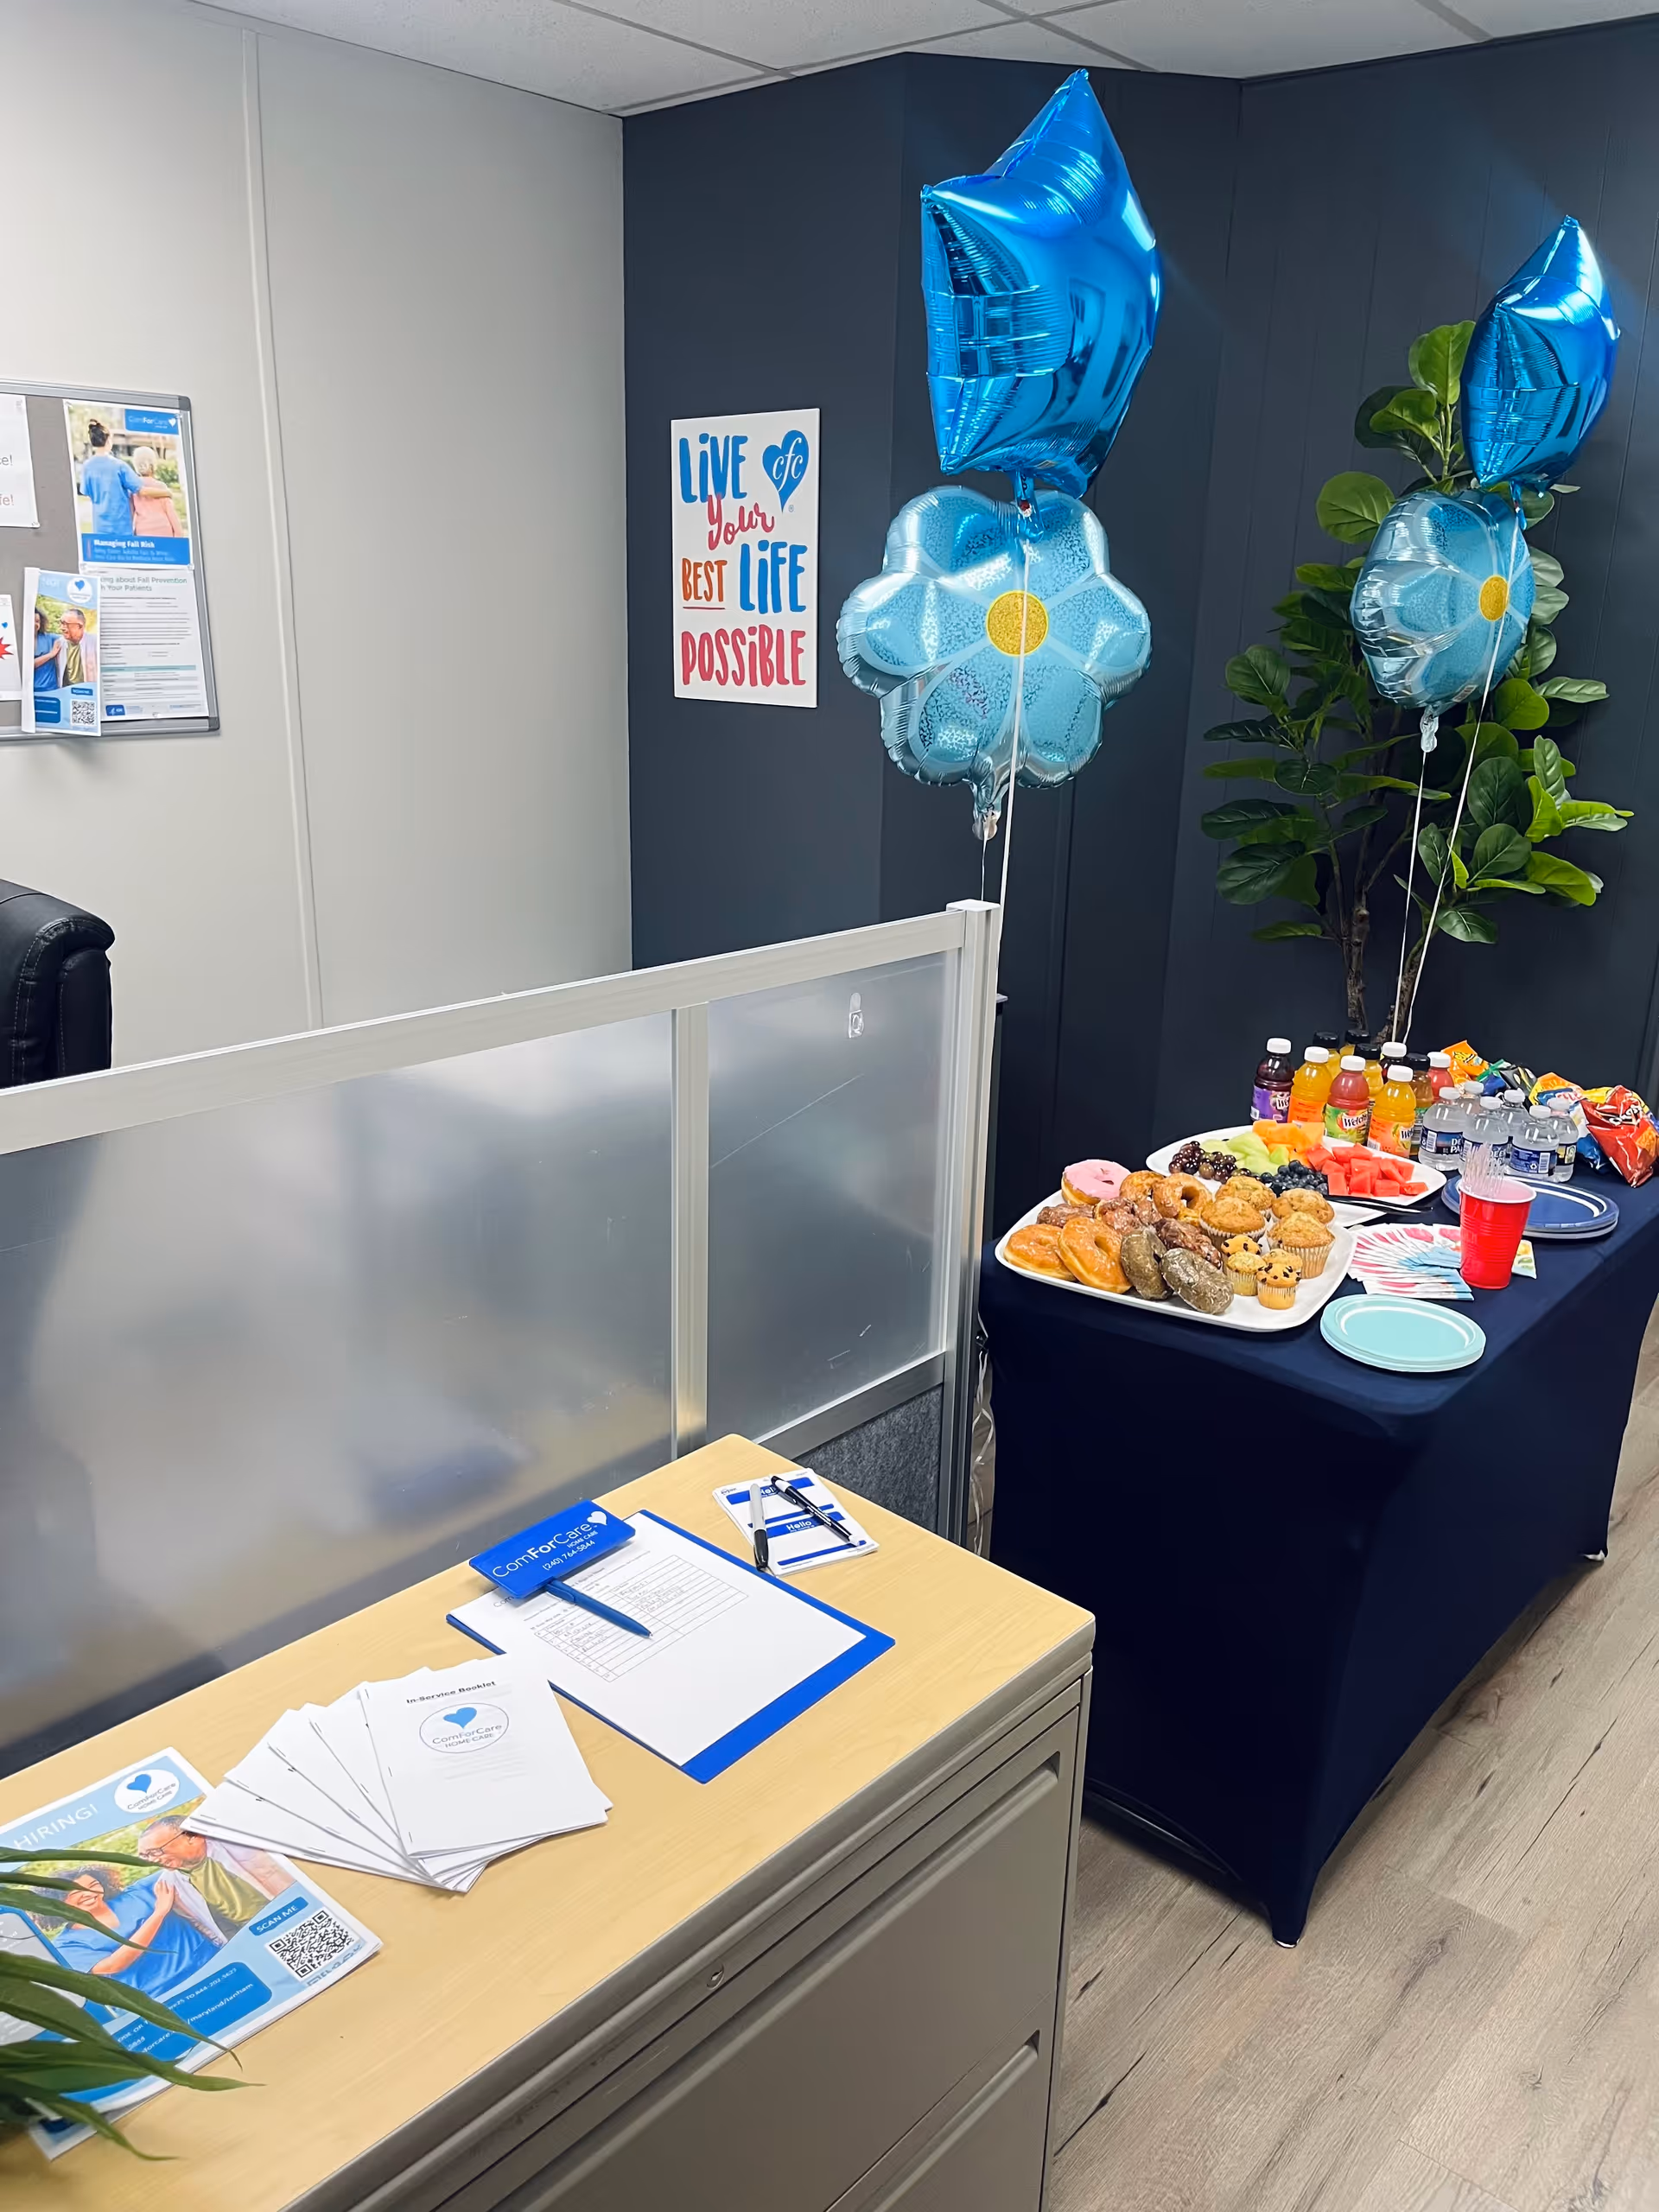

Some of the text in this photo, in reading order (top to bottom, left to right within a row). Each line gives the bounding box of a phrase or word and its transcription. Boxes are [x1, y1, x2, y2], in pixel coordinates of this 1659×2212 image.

[772, 436, 804, 493] cfc
[707, 492, 775, 550] Your
[93, 539, 127, 548] Managing
[682, 557, 728, 602] BEST
[785, 1520, 812, 1531] Hello
[492, 1522, 593, 1578] ComForCare
[567, 1530, 599, 1549] HOME CARE
[543, 1557, 564, 1571] (240)
[563, 1540, 595, 1560] 764-5844
[406, 1681, 497, 1704] In-Service Booklet
[432, 1724, 503, 1745] ComForCare
[445, 1732, 494, 1749] HOME CARE
[127, 1782, 177, 1810] ComForCare
[137, 1790, 174, 1810] HOME CARE
[13, 1802, 99, 1850] HIRING!
[256, 1904, 299, 1932] SCAN ME
[185, 1987, 196, 2001] TO
